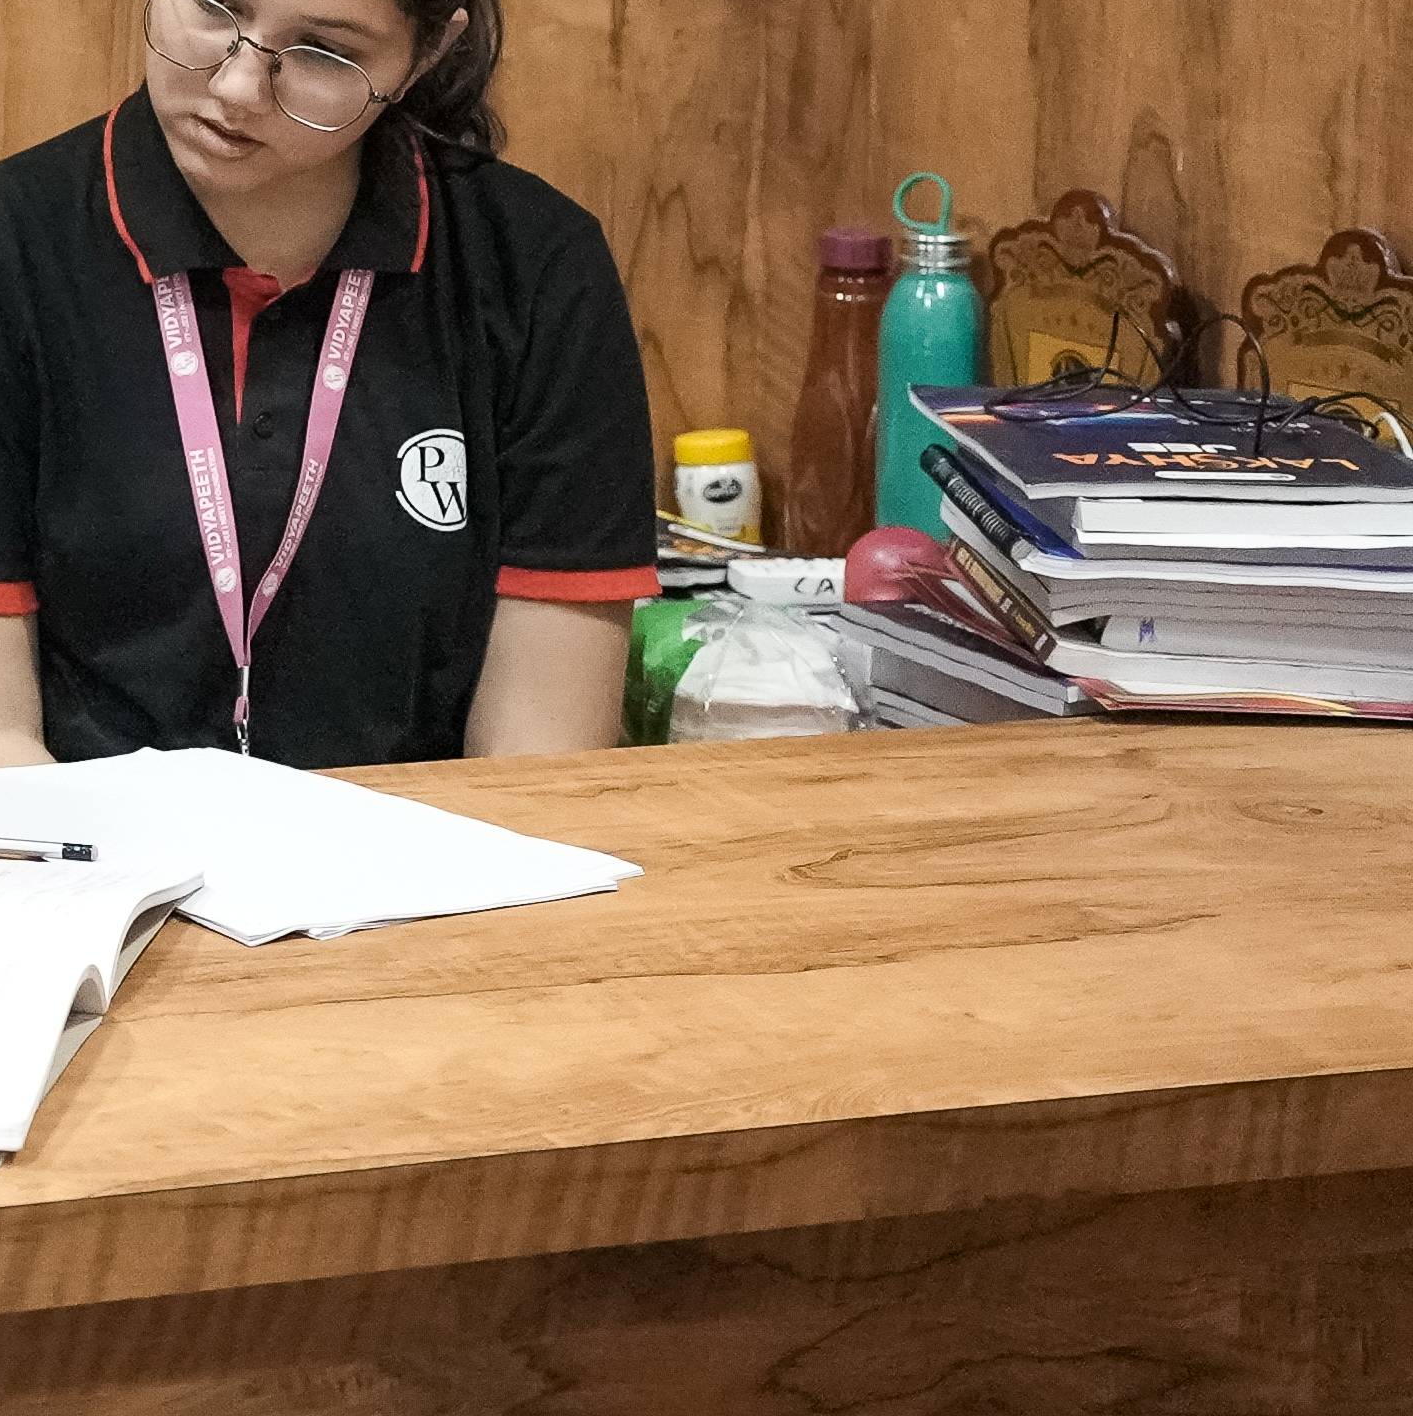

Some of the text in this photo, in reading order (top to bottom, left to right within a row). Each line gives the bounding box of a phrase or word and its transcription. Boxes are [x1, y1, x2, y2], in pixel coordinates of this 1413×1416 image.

[1127, 441, 1238, 454] JEE
[1051, 451, 1361, 471] LAKSHYA
[189, 448, 225, 566] VIDYAPEETH
